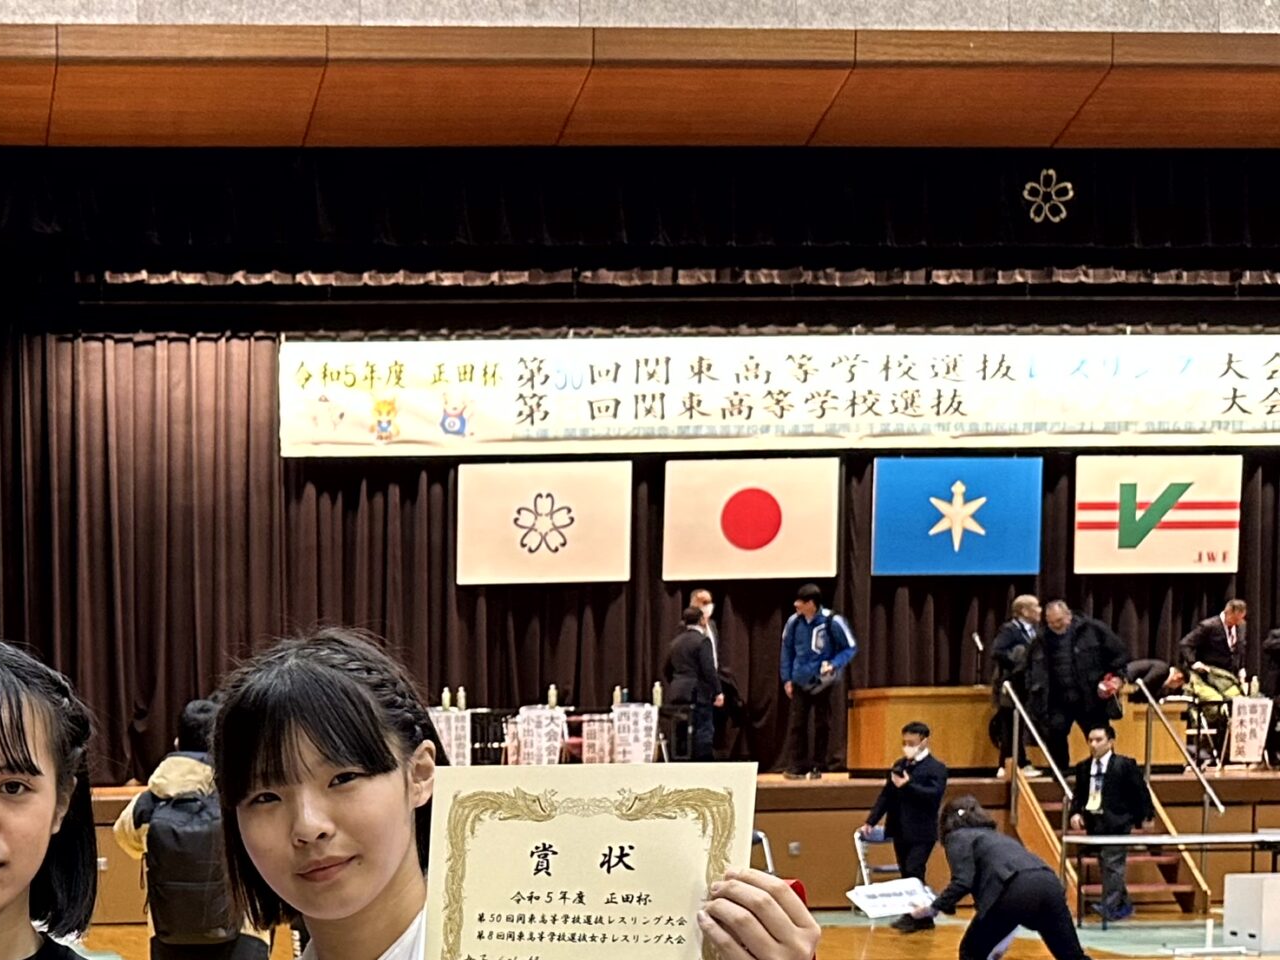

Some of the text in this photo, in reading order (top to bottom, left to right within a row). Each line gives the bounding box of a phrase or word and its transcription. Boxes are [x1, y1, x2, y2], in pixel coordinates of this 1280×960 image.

[511, 891, 652, 907] 令和5年度 正田杯
